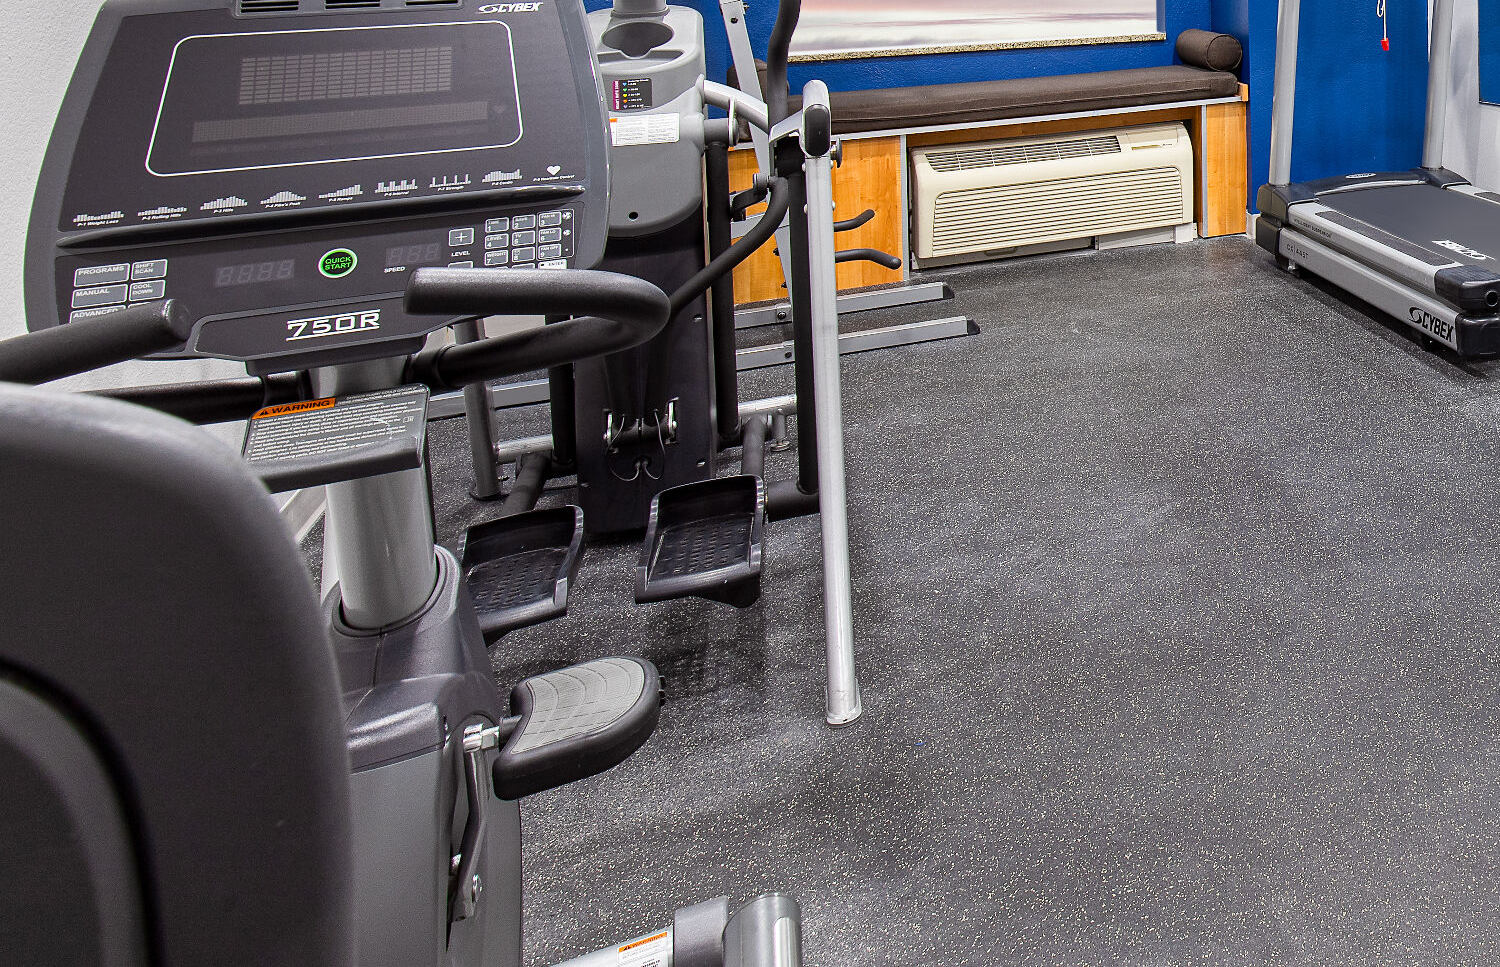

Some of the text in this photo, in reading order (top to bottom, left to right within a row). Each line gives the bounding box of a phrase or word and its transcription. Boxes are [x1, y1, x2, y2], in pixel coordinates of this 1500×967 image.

[497, 2, 544, 13] CYBEX
[325, 256, 351, 264] QUICK
[78, 266, 124, 275] PROGRAMS
[325, 262, 351, 270] START
[76, 288, 110, 297] MANUAL
[287, 313, 380, 337] 750R
[1422, 311, 1454, 342] CYBEX
[272, 401, 330, 413] WARNING
